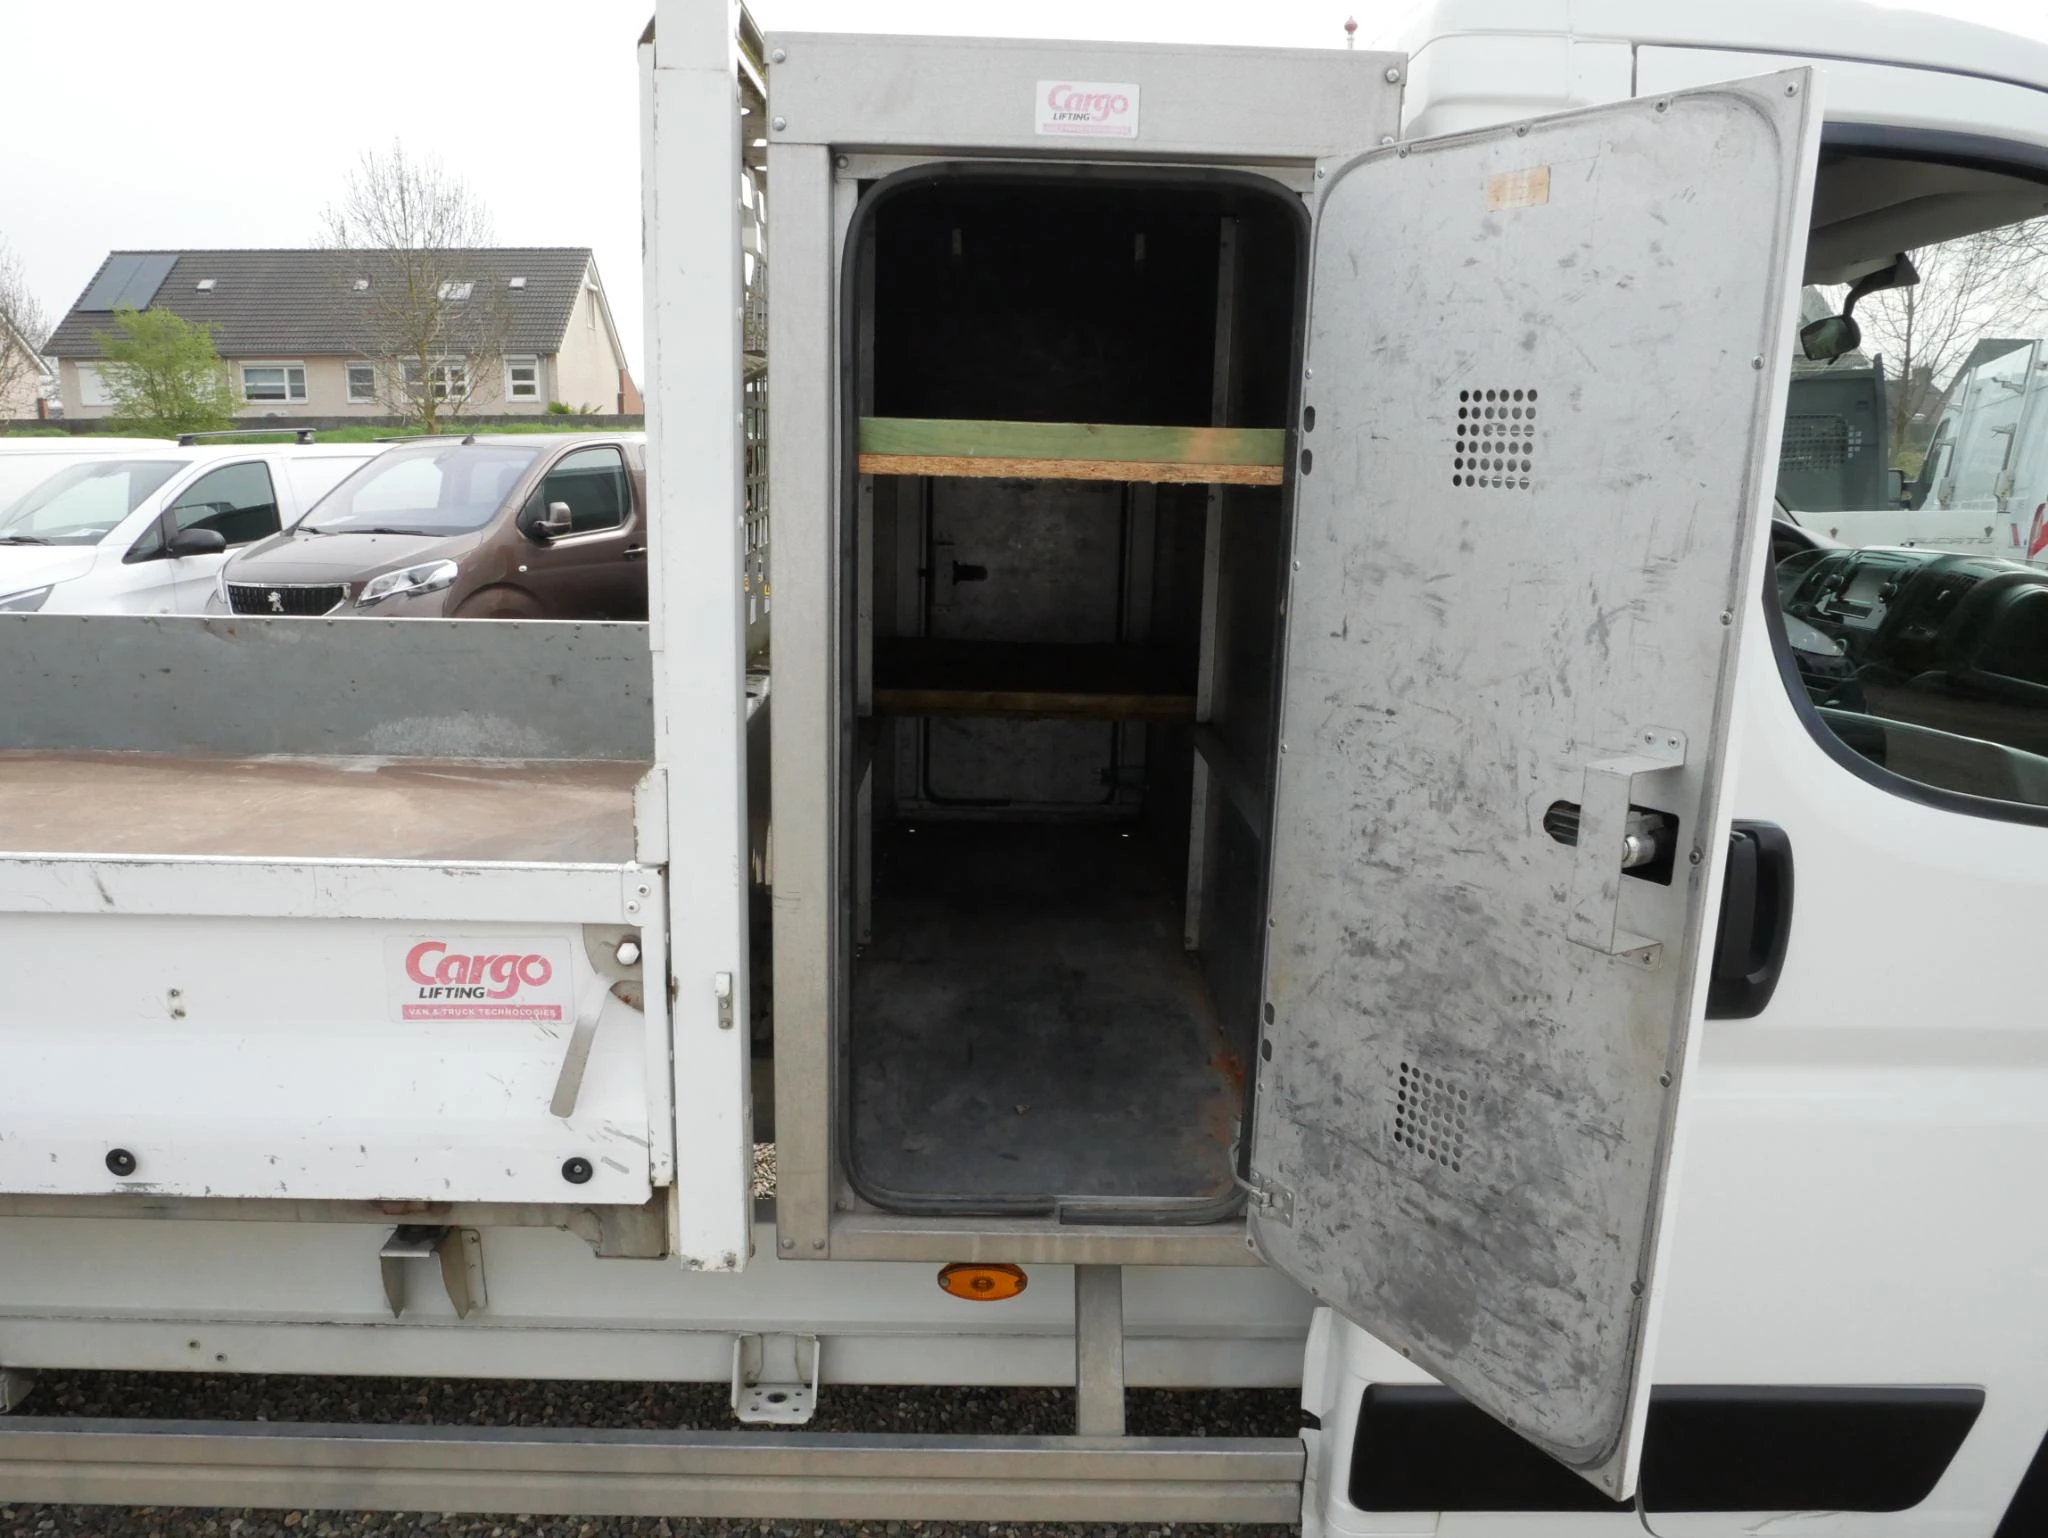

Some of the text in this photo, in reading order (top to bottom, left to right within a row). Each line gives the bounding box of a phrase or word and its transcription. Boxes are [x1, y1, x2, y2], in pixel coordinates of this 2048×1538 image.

[1048, 84, 1129, 121] Cargo
[1053, 112, 1090, 121] LIFTING
[405, 941, 553, 1000] Cargo
[419, 987, 485, 999] LIFTING
[409, 1008, 556, 1017] VAN & TRUCK TECHNOLOGIES
